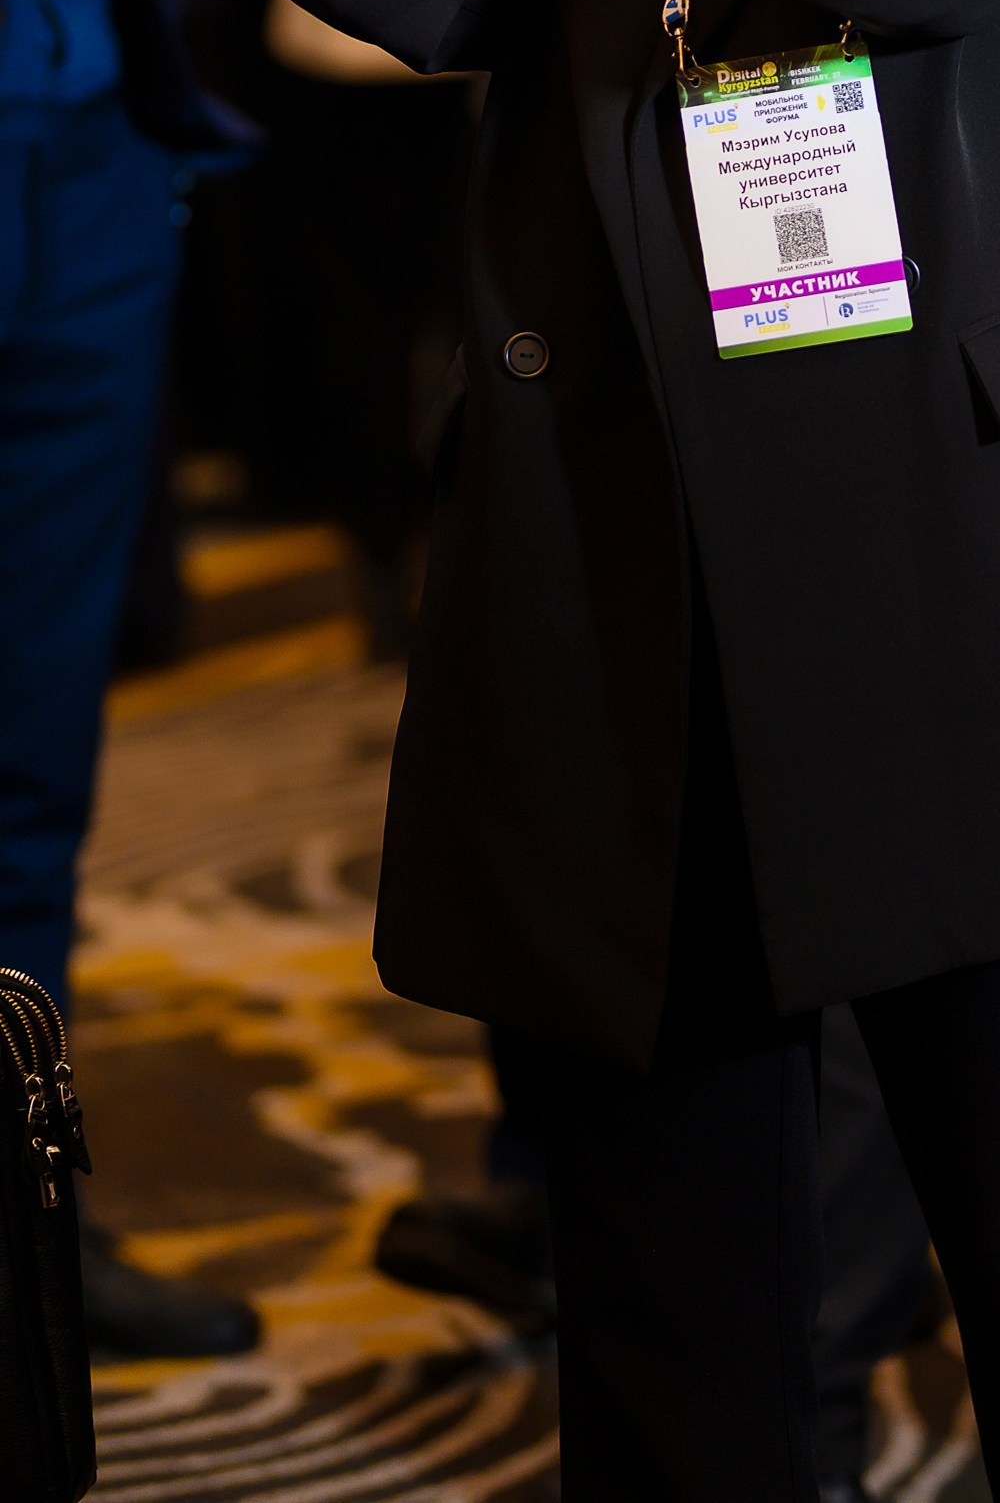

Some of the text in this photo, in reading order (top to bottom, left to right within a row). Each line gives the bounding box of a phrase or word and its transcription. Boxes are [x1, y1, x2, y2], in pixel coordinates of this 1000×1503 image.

[717, 67, 761, 84] Digital
[789, 65, 821, 77] BISHKEK
[718, 75, 779, 94] Kyrgyzstan
[754, 102, 808, 117] ПРИЛОЖЕНИЕ
[755, 94, 804, 108] МОБИЛЬНОЕ
[693, 108, 737, 128] PLUS
[765, 113, 800, 124] ФОРУМА
[721, 122, 846, 153] Мээрим Усупова
[718, 139, 857, 175] Международный
[739, 163, 841, 193] университет
[739, 182, 848, 210] Кыргызстана
[794, 258, 834, 270] КОНТАКТЫ
[750, 271, 861, 302] УЧАСТНИК
[744, 308, 788, 327] PLUS
